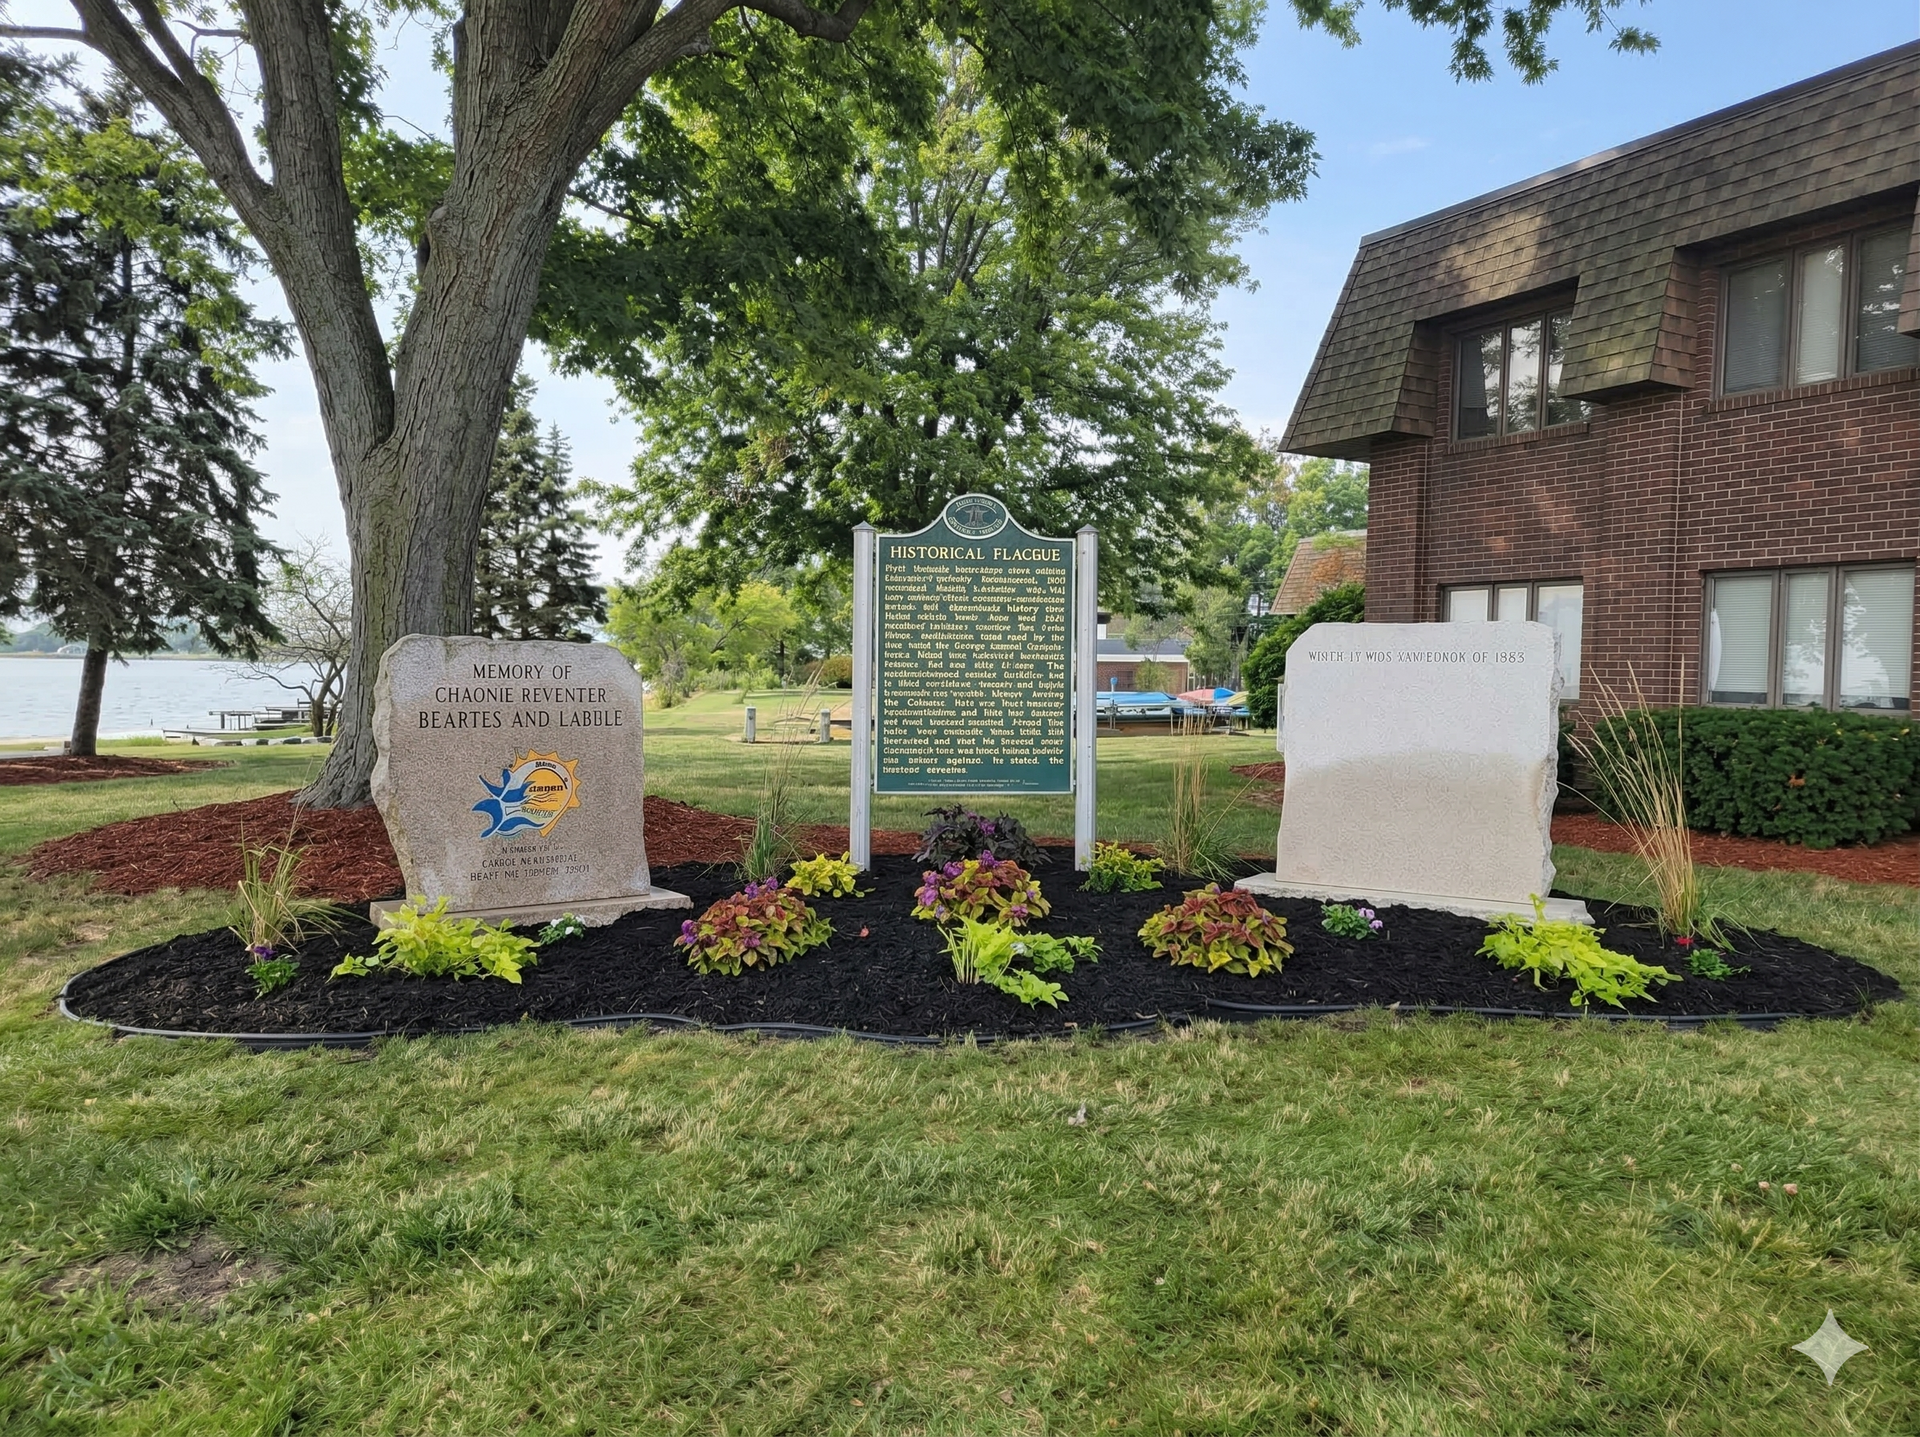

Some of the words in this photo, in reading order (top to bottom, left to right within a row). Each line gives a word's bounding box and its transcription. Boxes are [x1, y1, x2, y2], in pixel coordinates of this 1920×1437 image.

[890, 546, 986, 560] HISTORICAL
[954, 642, 986, 651] George
[1472, 651, 1489, 664] OF
[473, 664, 544, 680] MEMORY
[552, 665, 572, 680] OF
[1046, 662, 1065, 670] The
[435, 687, 514, 703] CHAONIE
[522, 688, 607, 703] REVENTER
[961, 708, 978, 717] and
[418, 710, 502, 729] BEARTES
[511, 710, 550, 728] AND
[934, 736, 950, 746] and
